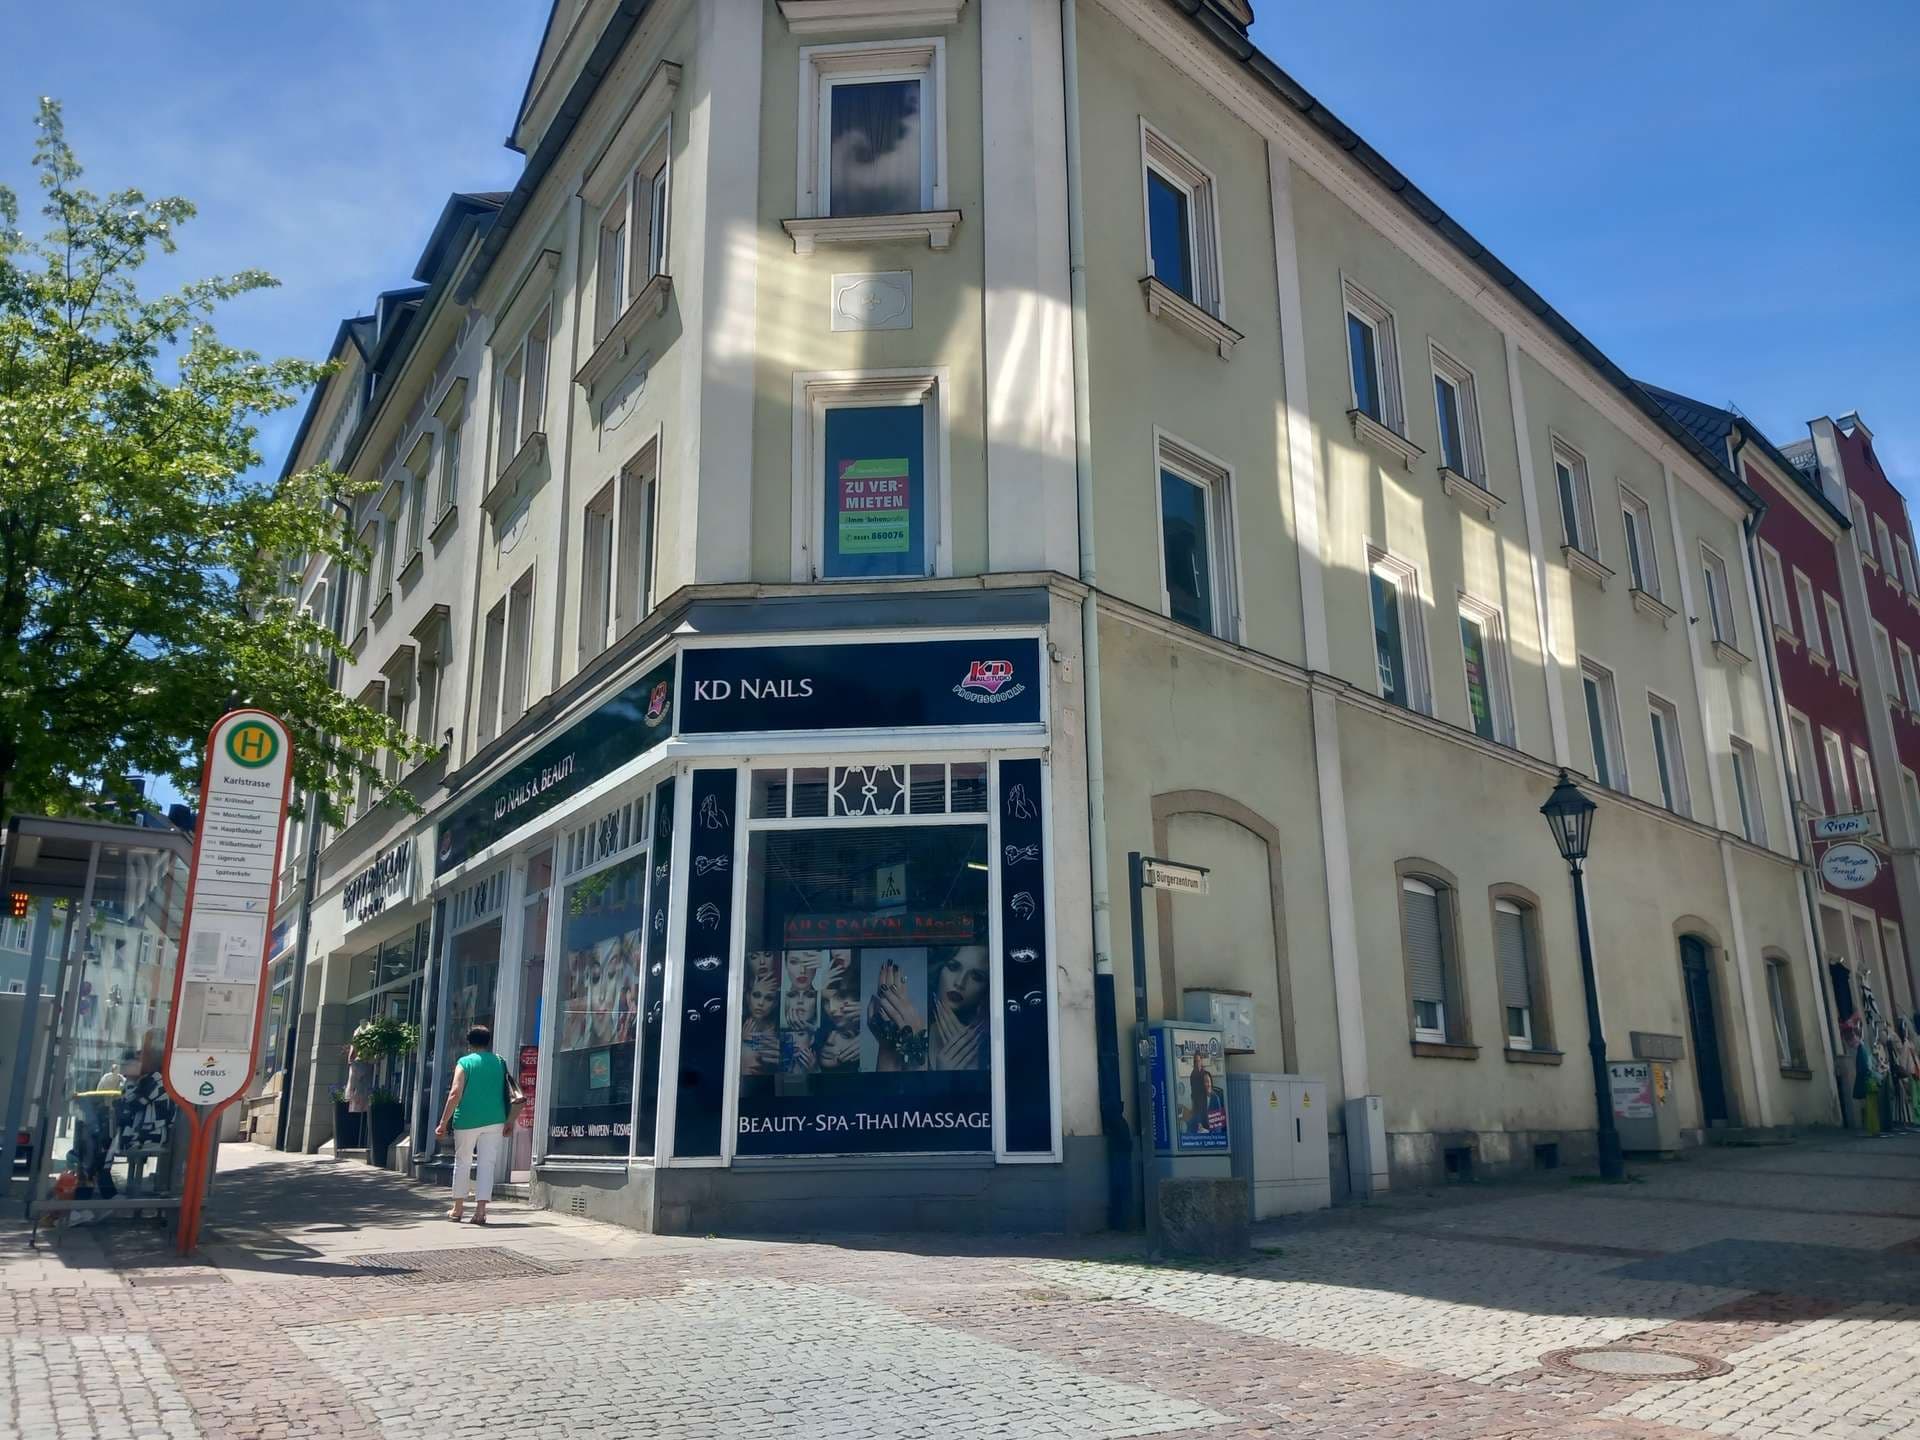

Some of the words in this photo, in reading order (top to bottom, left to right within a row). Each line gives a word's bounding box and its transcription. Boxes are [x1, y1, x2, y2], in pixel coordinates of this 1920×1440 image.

[845, 481, 864, 493] ZU
[869, 480, 903, 493] VER-
[845, 495, 903, 509] MIETEN
[969, 660, 1013, 681] KD
[694, 679, 731, 701] KD
[740, 678, 814, 699] NAILS
[952, 683, 1026, 704] PROFESSIONAL
[240, 730, 265, 759] H
[223, 776, 271, 789] Karlstrasse
[494, 796, 506, 820] KD
[507, 781, 531, 813] NAILS
[540, 752, 576, 792] BEAUTY
[220, 825, 262, 835] Hauptbahnhof
[1824, 819, 1859, 832] Pippi
[1156, 870, 1199, 889] Bürgerzentrum
[1184, 1039, 1209, 1053] Allianz
[1623, 1066, 1647, 1078] Mai
[901, 1111, 991, 1129] MASSAGE
